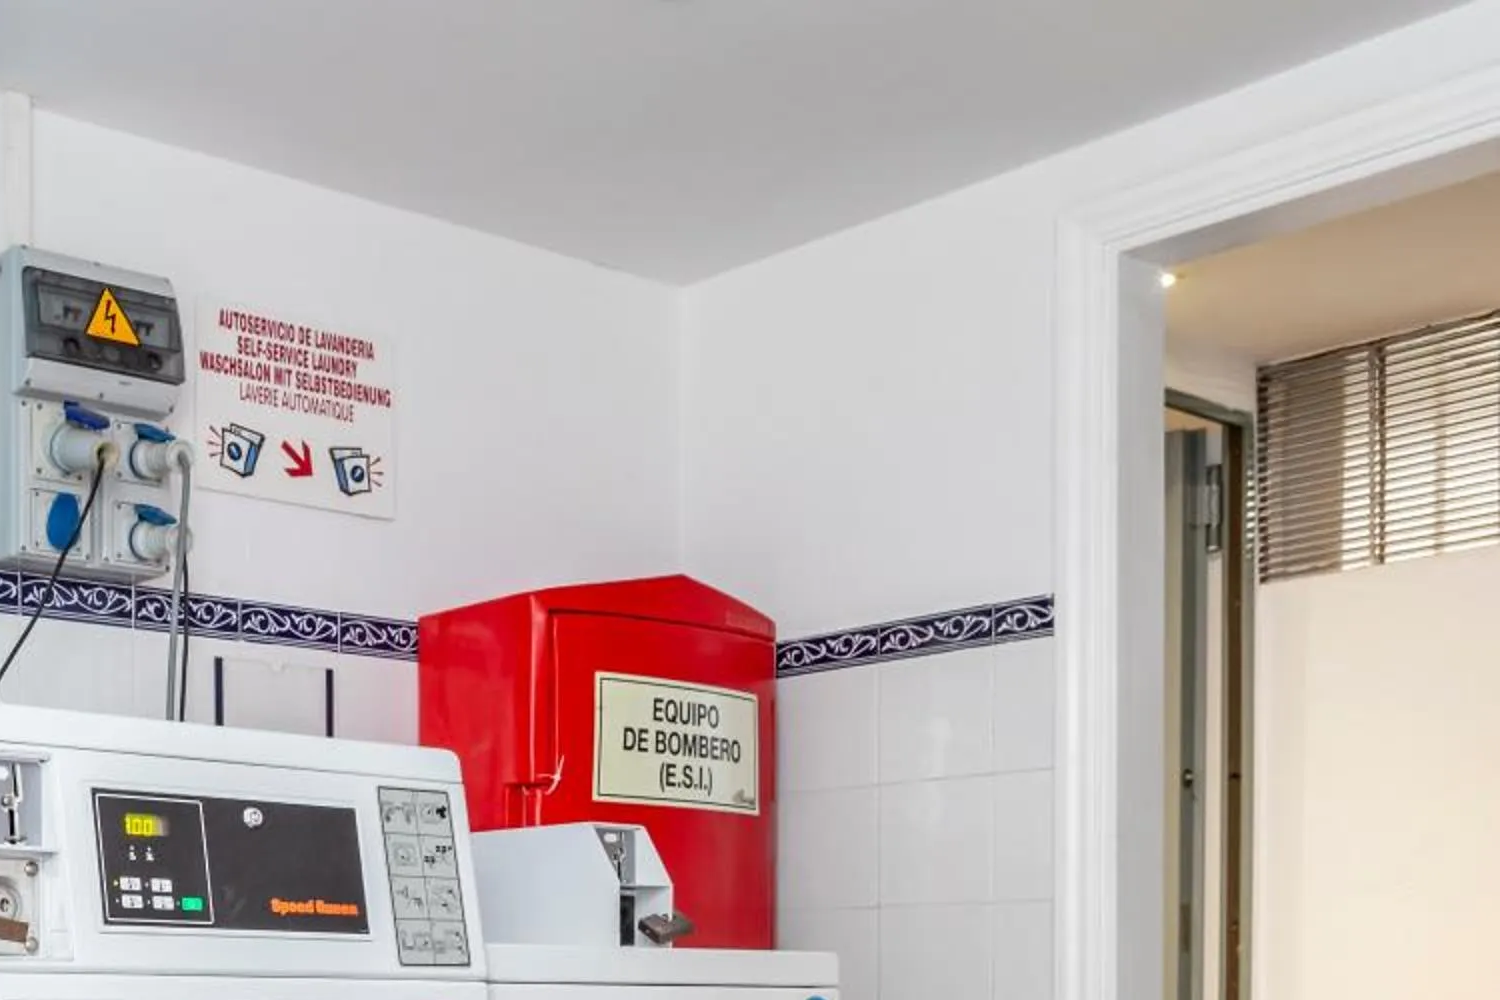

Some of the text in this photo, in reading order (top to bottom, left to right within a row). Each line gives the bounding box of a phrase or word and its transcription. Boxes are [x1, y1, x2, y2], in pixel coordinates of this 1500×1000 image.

[219, 308, 374, 360] AUTOSERVICIO DE LAVANDERIA
[237, 336, 357, 378] SELF-SERVICE LAUNDRY
[199, 351, 391, 408] WASCHSALON MIT SELBSTBEDIENUNG
[239, 383, 354, 422] LAVERIE AUTOMATIQUE
[653, 697, 720, 729] EQUIPO
[623, 727, 741, 763] DE BOMBERO
[659, 762, 713, 796] (E.S.I.)
[270, 897, 315, 916] Speed
